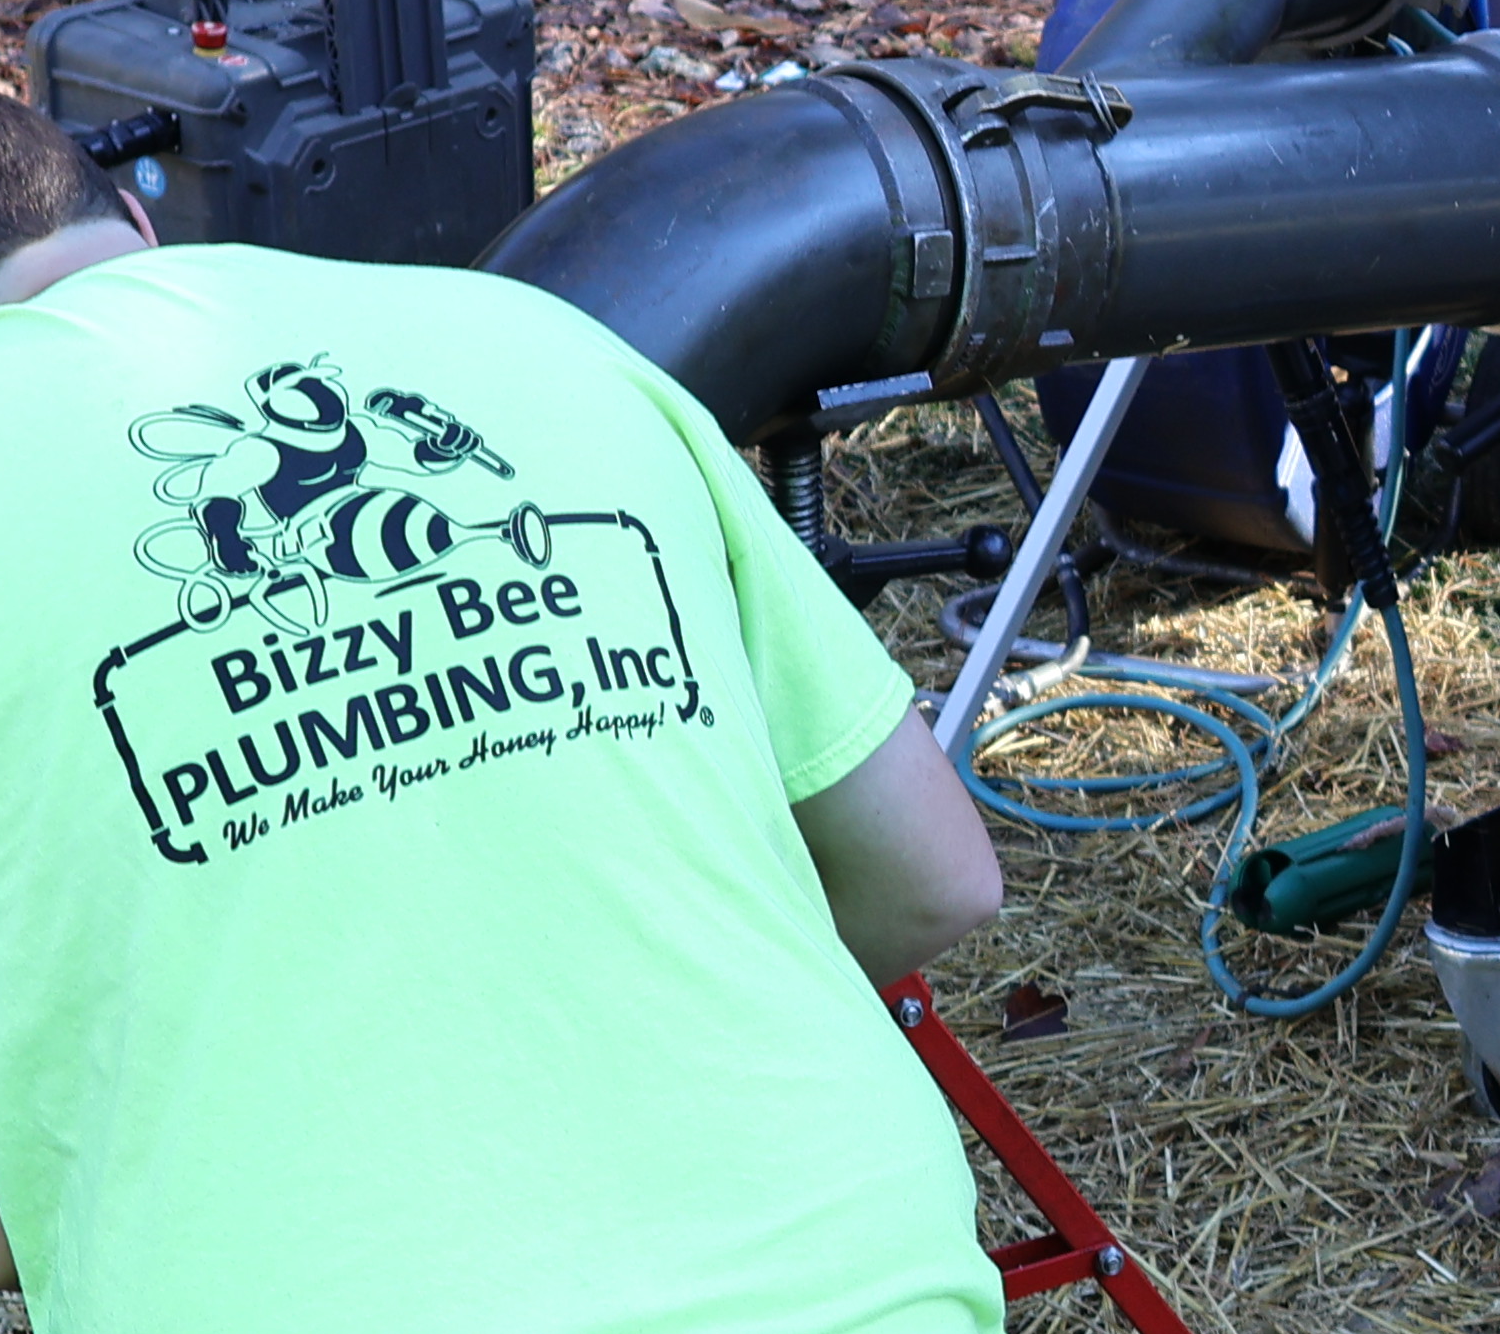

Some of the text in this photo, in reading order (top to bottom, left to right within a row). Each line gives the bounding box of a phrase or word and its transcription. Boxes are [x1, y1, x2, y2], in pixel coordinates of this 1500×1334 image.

[211, 574, 582, 714] Bizzy Bee
[222, 701, 665, 851] We Make Your Honey Happy!
